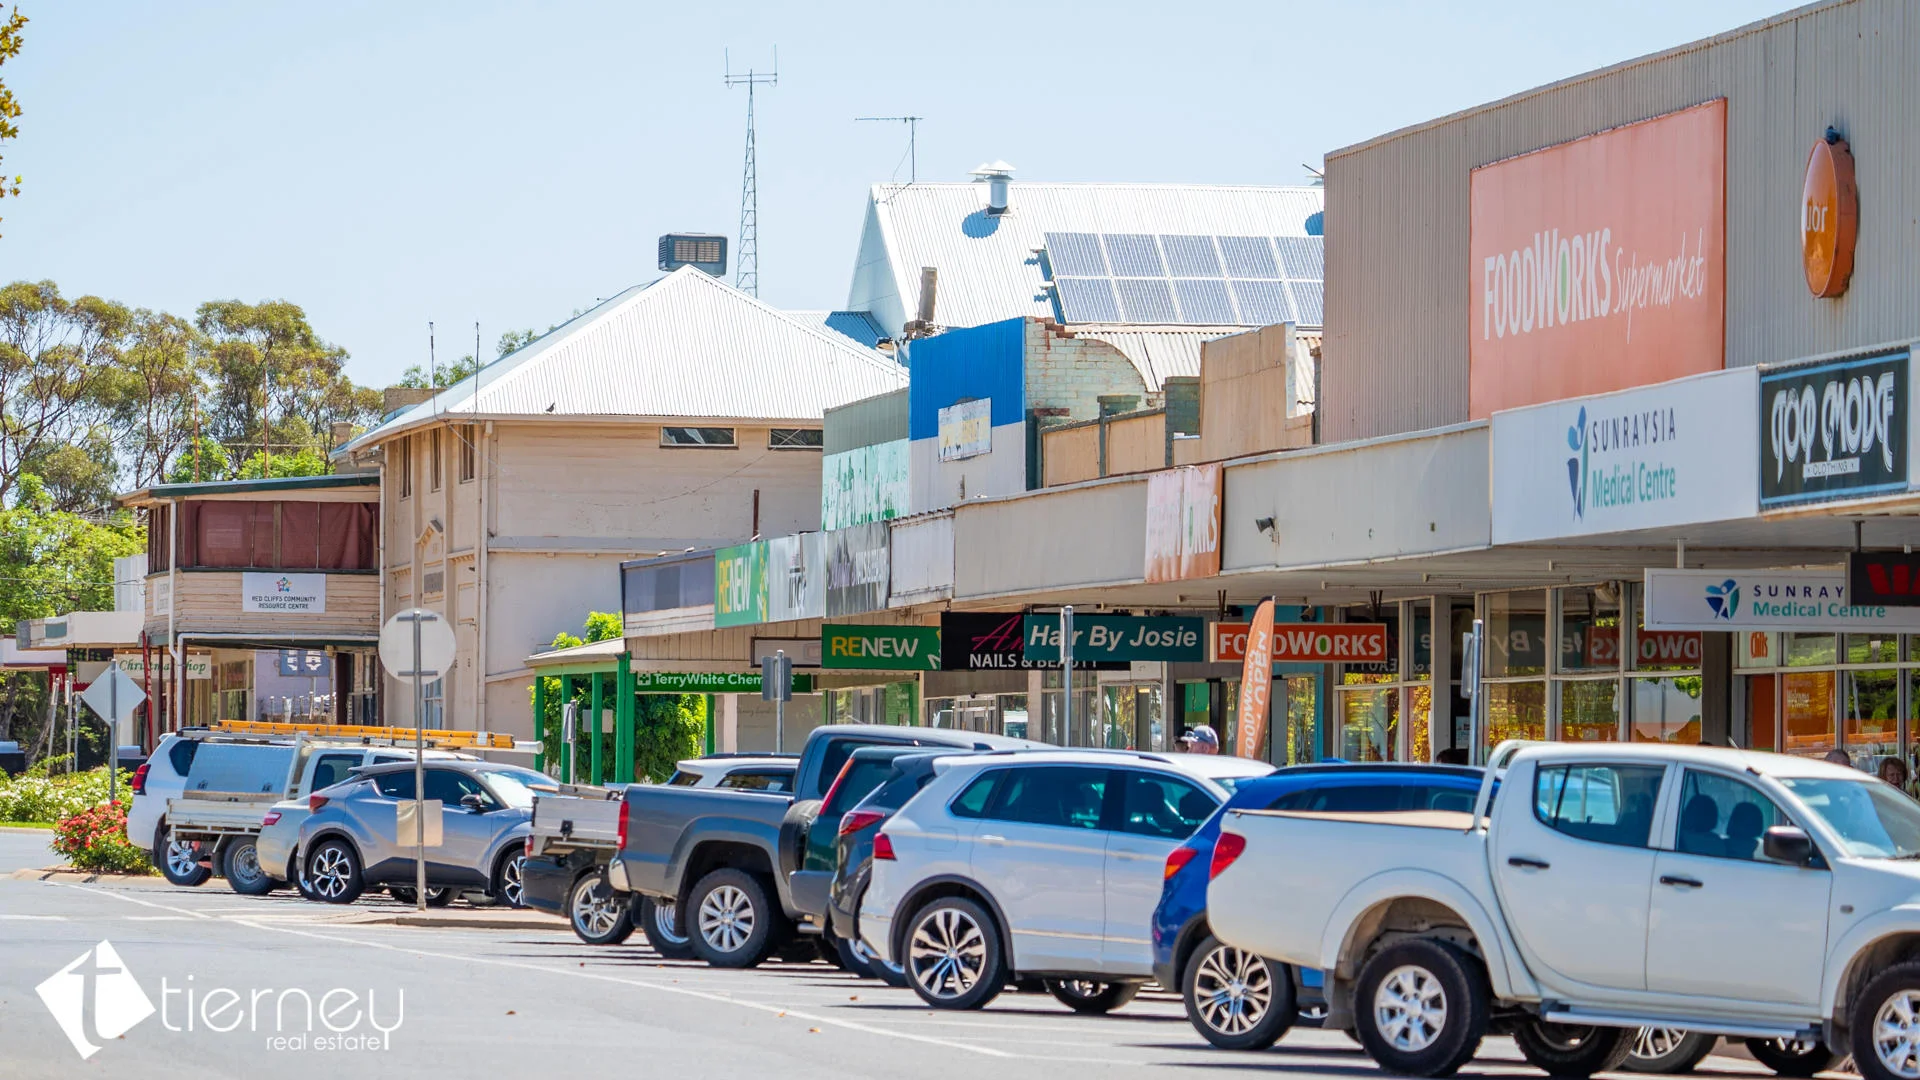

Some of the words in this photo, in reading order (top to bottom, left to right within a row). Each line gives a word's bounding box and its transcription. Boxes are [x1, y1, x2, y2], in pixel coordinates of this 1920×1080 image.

[1484, 227, 1611, 340] FOODWORKS
[1613, 228, 1704, 344] Supermarket
[1592, 407, 1676, 453] SUNRAYSIA
[1592, 461, 1635, 508] Medical
[1639, 461, 1676, 502] Centre
[718, 557, 750, 614] RENEW
[1753, 584, 1844, 598] SUNRAY
[1753, 602, 1822, 617] Medical
[1828, 603, 1886, 618] Centre
[831, 636, 919, 658] RENEW
[1030, 625, 1083, 647] Har
[1089, 626, 1124, 651] By
[1130, 626, 1197, 647] Josie
[1219, 631, 1381, 657] FODWORKS
[186, 659, 206, 675] hop
[969, 653, 1017, 668] NAILS
[654, 673, 725, 687] TerryWhite
